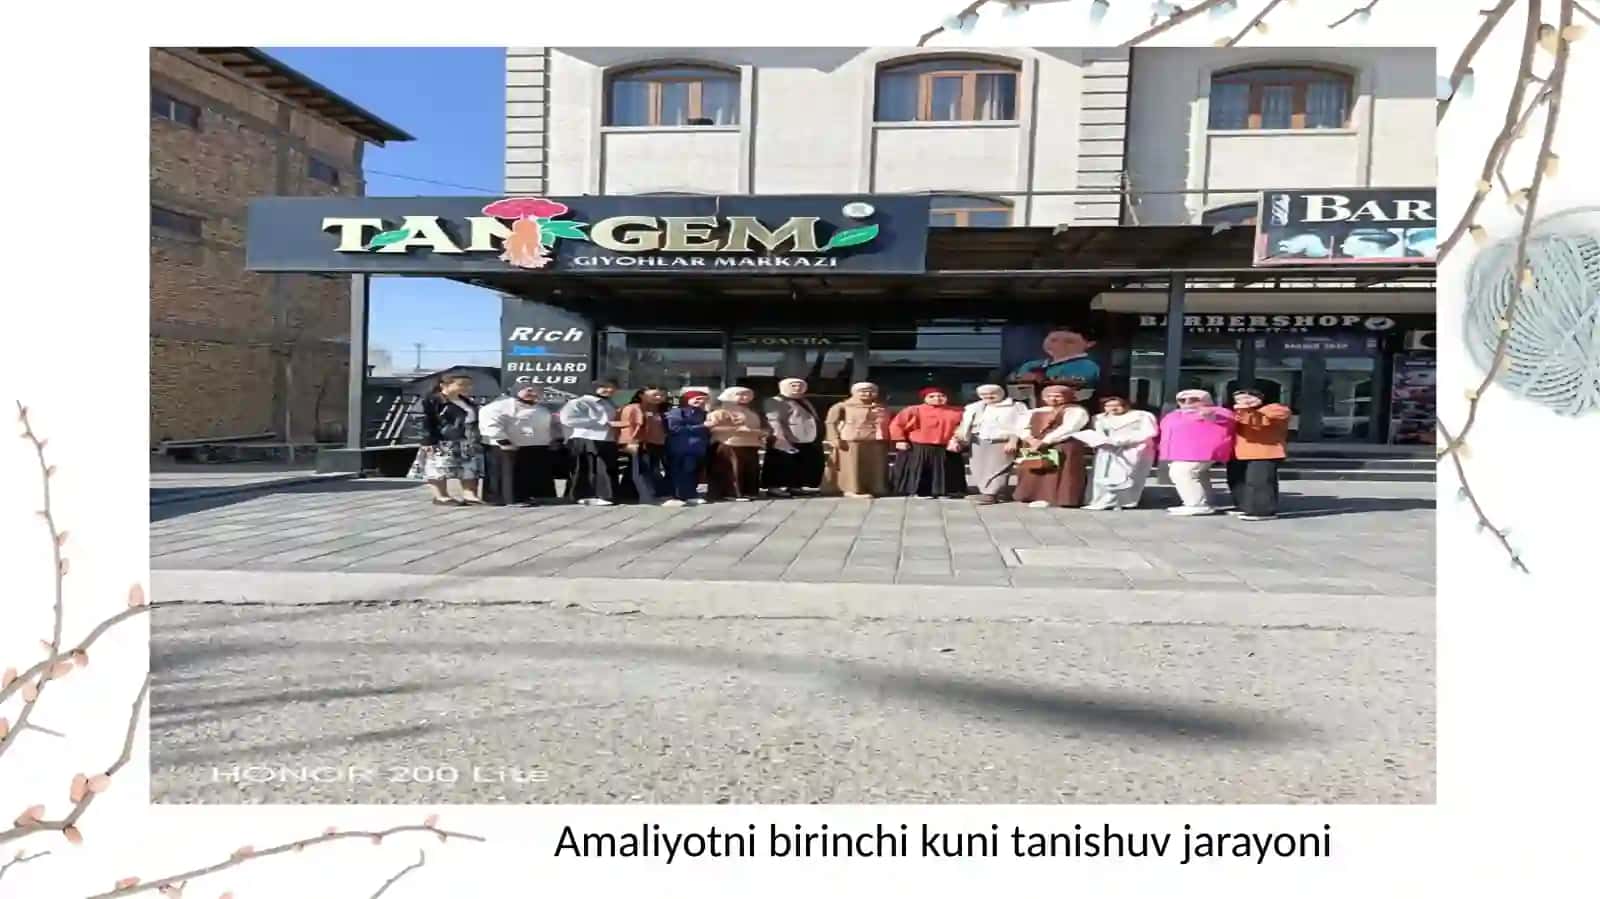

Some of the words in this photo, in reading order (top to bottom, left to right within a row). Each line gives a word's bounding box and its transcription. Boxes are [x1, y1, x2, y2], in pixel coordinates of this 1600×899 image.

[1300, 194, 1436, 222] BAR
[573, 256, 706, 267] GIYOHLAR
[714, 256, 838, 267] MARKAZI
[508, 327, 584, 342] Rich
[507, 362, 587, 373] BILLIARD
[515, 375, 578, 384] CLUB
